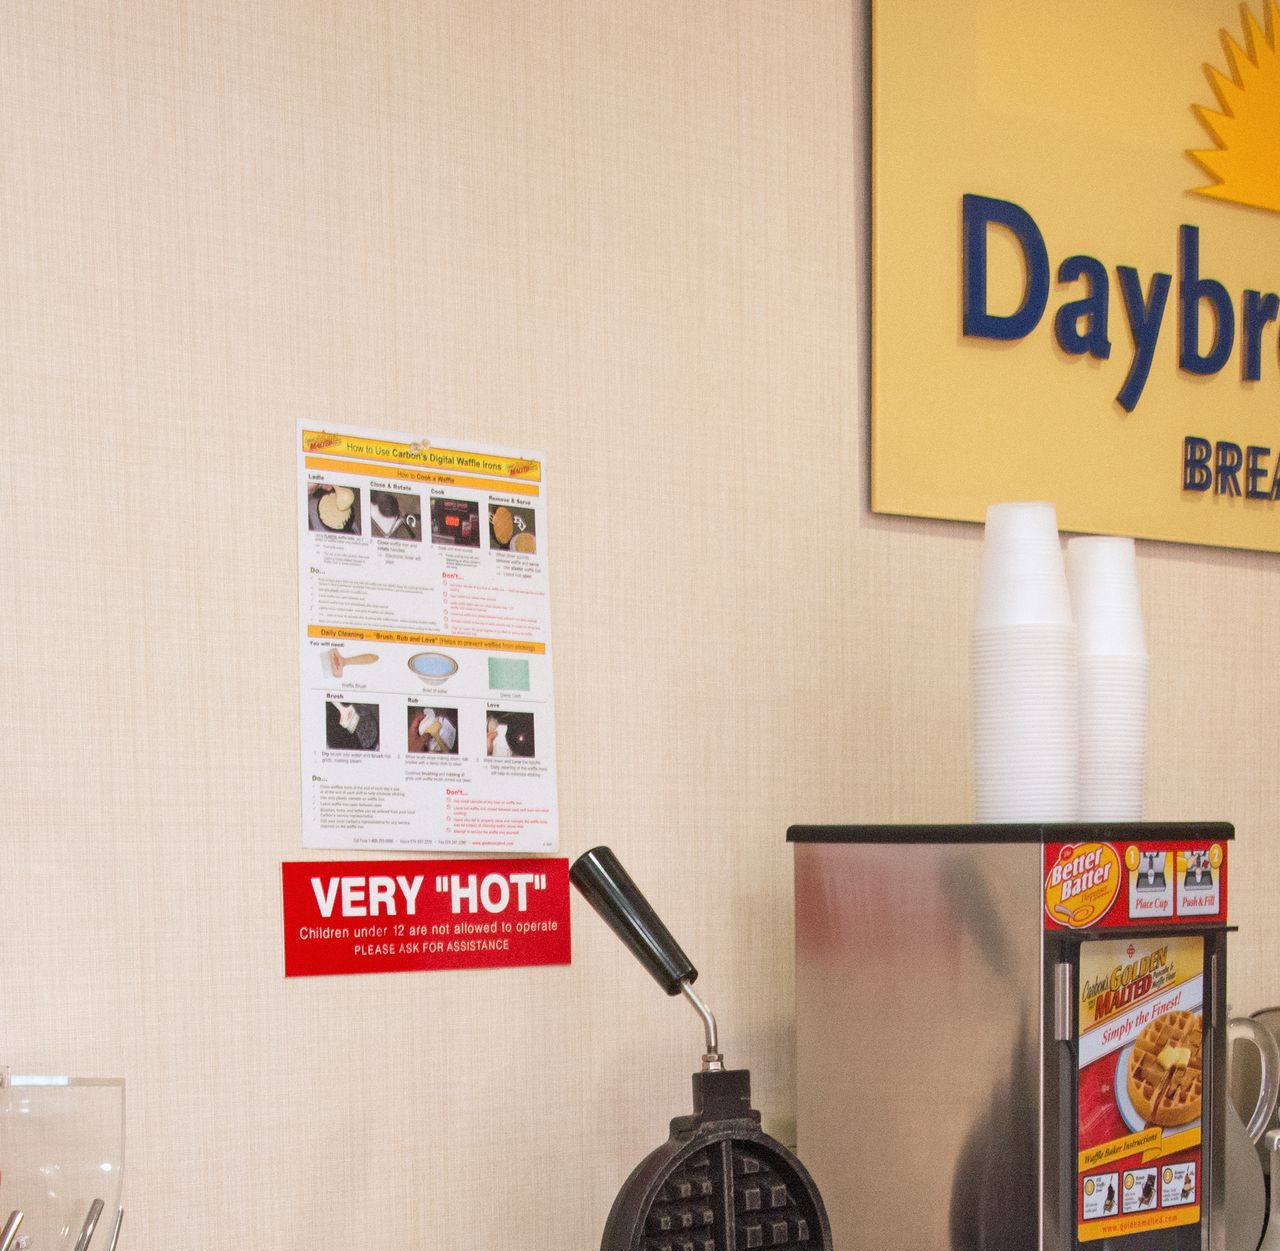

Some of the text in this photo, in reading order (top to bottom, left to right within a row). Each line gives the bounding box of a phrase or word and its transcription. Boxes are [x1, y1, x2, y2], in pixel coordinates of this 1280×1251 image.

[347, 442, 502, 471] How to Use Carbon's Digital Waffle Irons
[320, 629, 337, 637] Daily
[337, 631, 364, 639] Cleaning
[410, 635, 420, 643] and
[1051, 846, 1103, 887] Better
[1061, 862, 1111, 902] Batter
[310, 873, 546, 917] VERY "HOT"
[1136, 897, 1169, 911] Place Cup
[1182, 895, 1215, 908] Push & Fill
[299, 921, 558, 940] Children under 12 are not allowed to operate
[354, 939, 509, 956] PLEASE ASK FOR ASSISTANCE
[1109, 944, 1169, 992] GOLDEN
[1094, 974, 1153, 1021] MALTED
[1102, 991, 1182, 1046] Simply the Finest!
[1084, 1134, 1158, 1165] Waffle Baker Instructions
